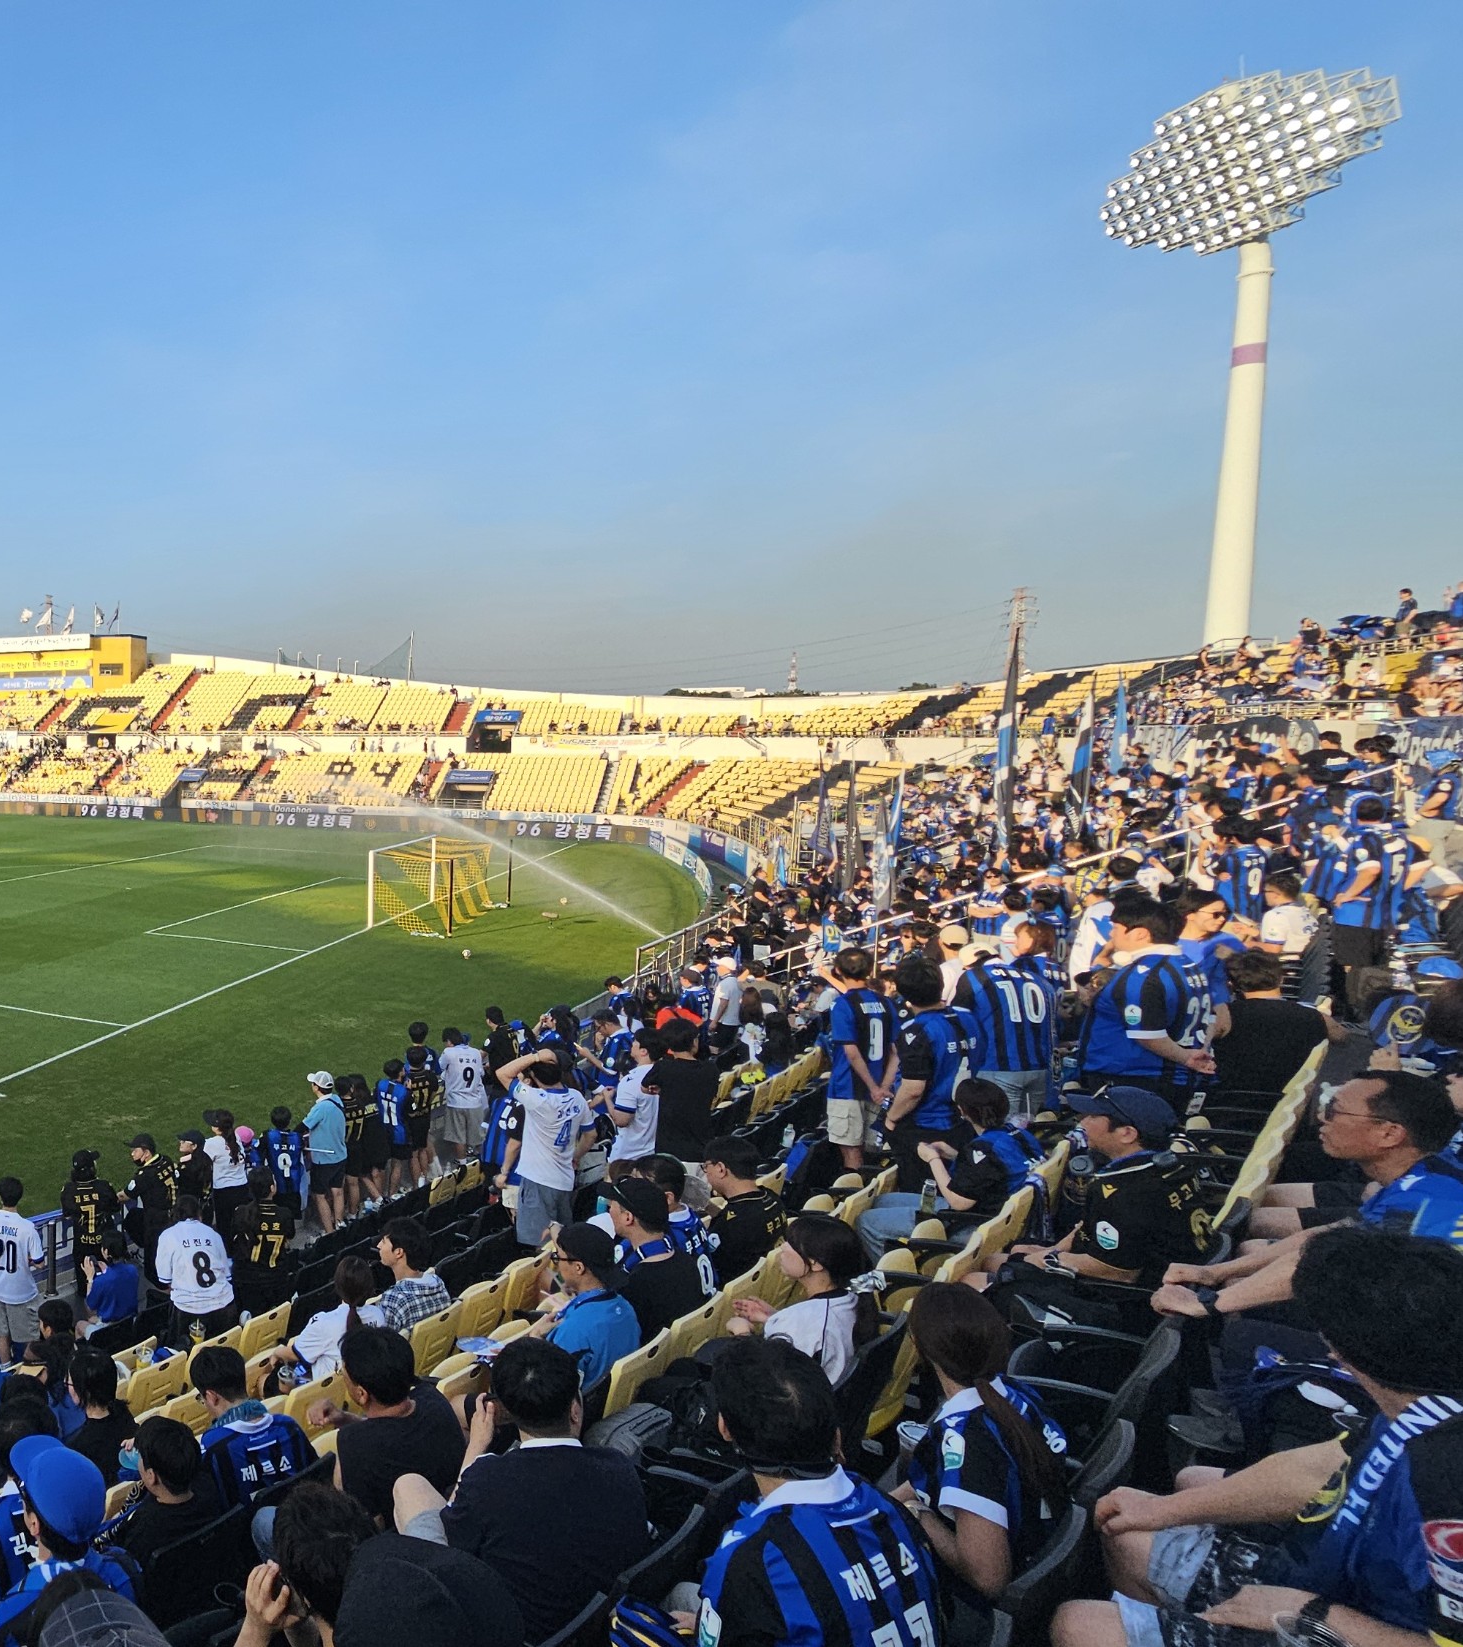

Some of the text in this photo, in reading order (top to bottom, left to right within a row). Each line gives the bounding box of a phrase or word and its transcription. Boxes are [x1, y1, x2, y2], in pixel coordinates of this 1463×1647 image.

[81, 804, 98, 817] 96
[275, 812, 296, 826] 96
[516, 823, 541, 837] 96
[1247, 867, 1263, 896] 9
[996, 980, 1046, 1024] 10
[868, 1018, 884, 1062] 9
[462, 1066, 475, 1089] 9
[381, 1099, 399, 1126] 11
[553, 1118, 573, 1153] 4
[277, 1152, 293, 1178] 9
[80, 1204, 96, 1234] 7
[182, 1238, 213, 1248] 신진호
[191, 1251, 217, 1289] 8
[240, 1454, 292, 1483] 제르소
[840, 1542, 919, 1601] 제르소
